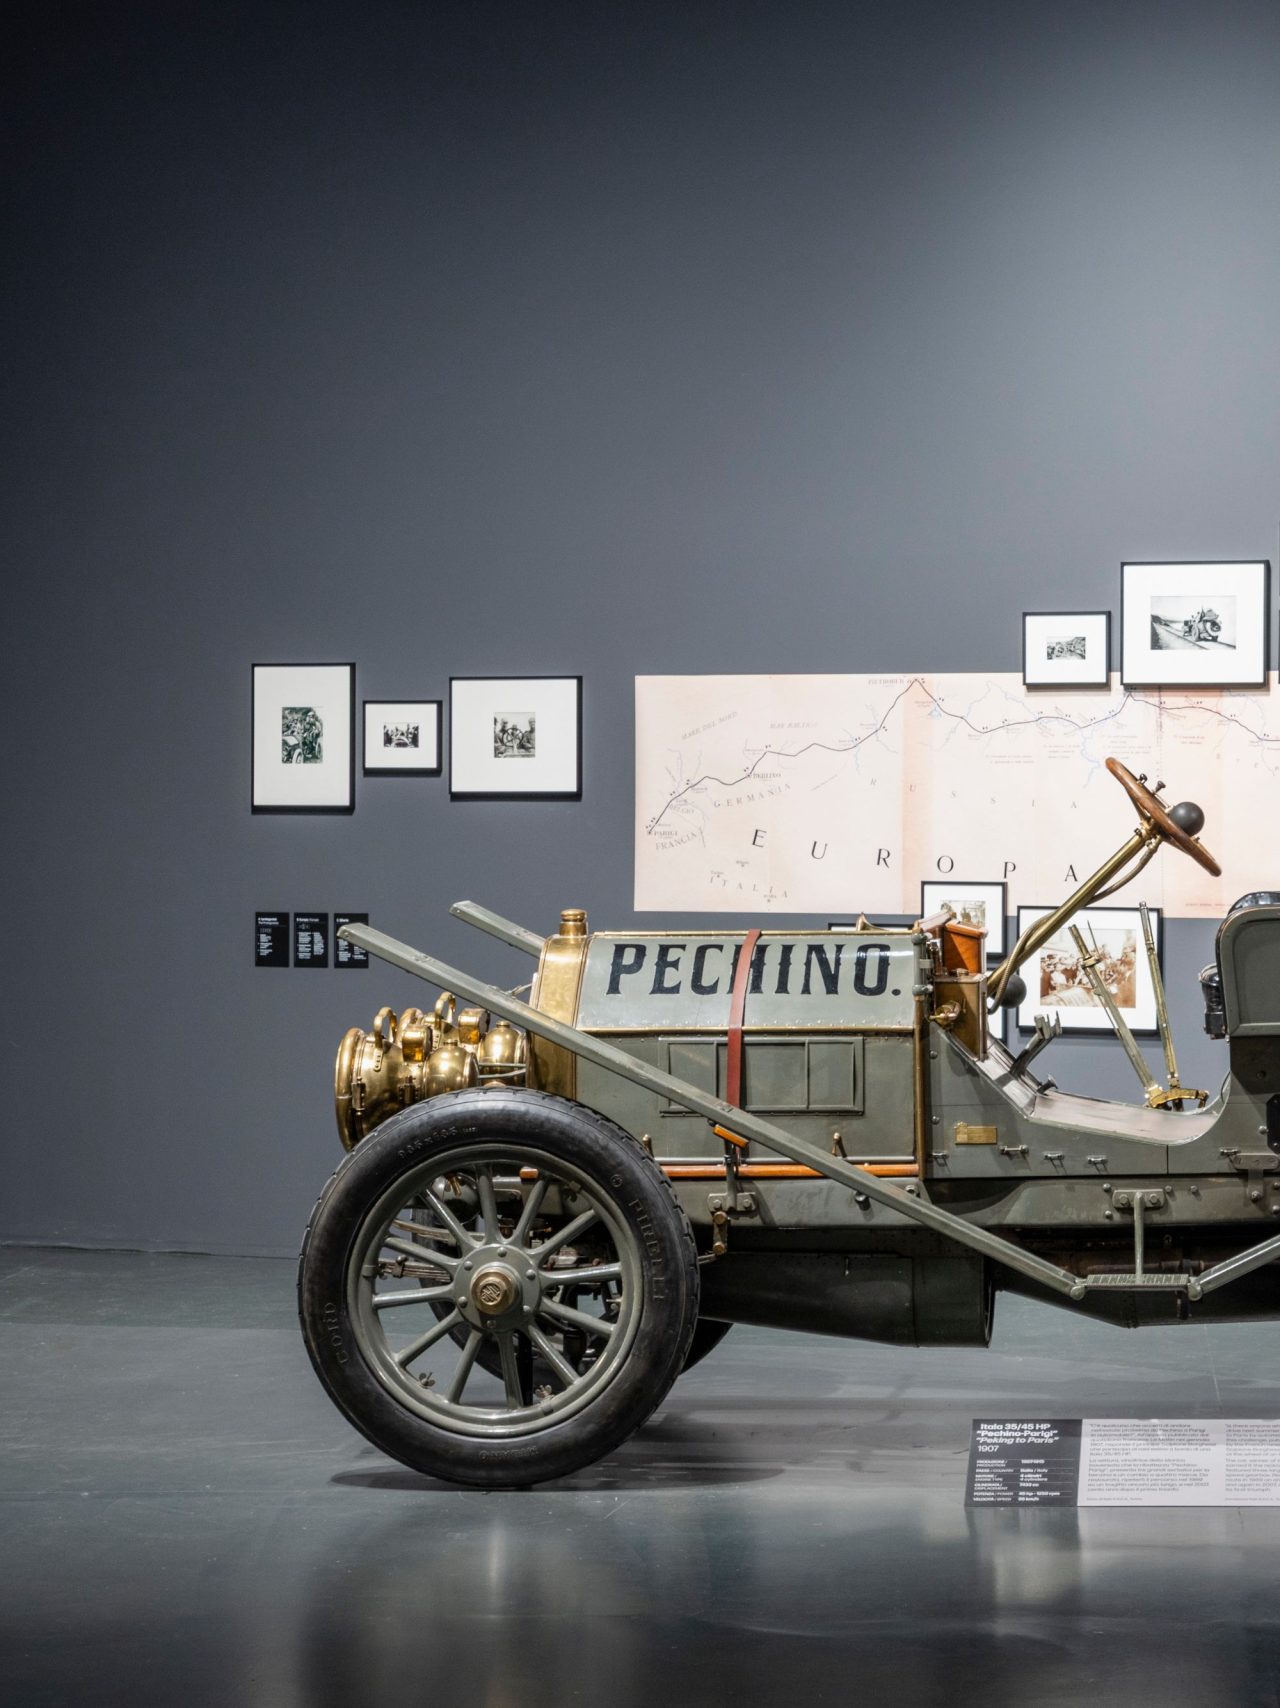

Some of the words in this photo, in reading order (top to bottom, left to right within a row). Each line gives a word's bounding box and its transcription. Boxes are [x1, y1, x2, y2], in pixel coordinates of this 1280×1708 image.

[605, 943, 902, 997] PECHINO.
[628, 1199, 665, 1299] PIRELLI
[323, 1302, 349, 1364] CORD
[980, 1423, 1003, 1431] Itala
[1004, 1423, 1034, 1431] 35/45
[1035, 1423, 1051, 1431] HP
[976, 1430, 1058, 1439] "Pechino-Parigi"
[976, 1437, 1015, 1445] "Peking
[977, 1444, 999, 1453] 1907
